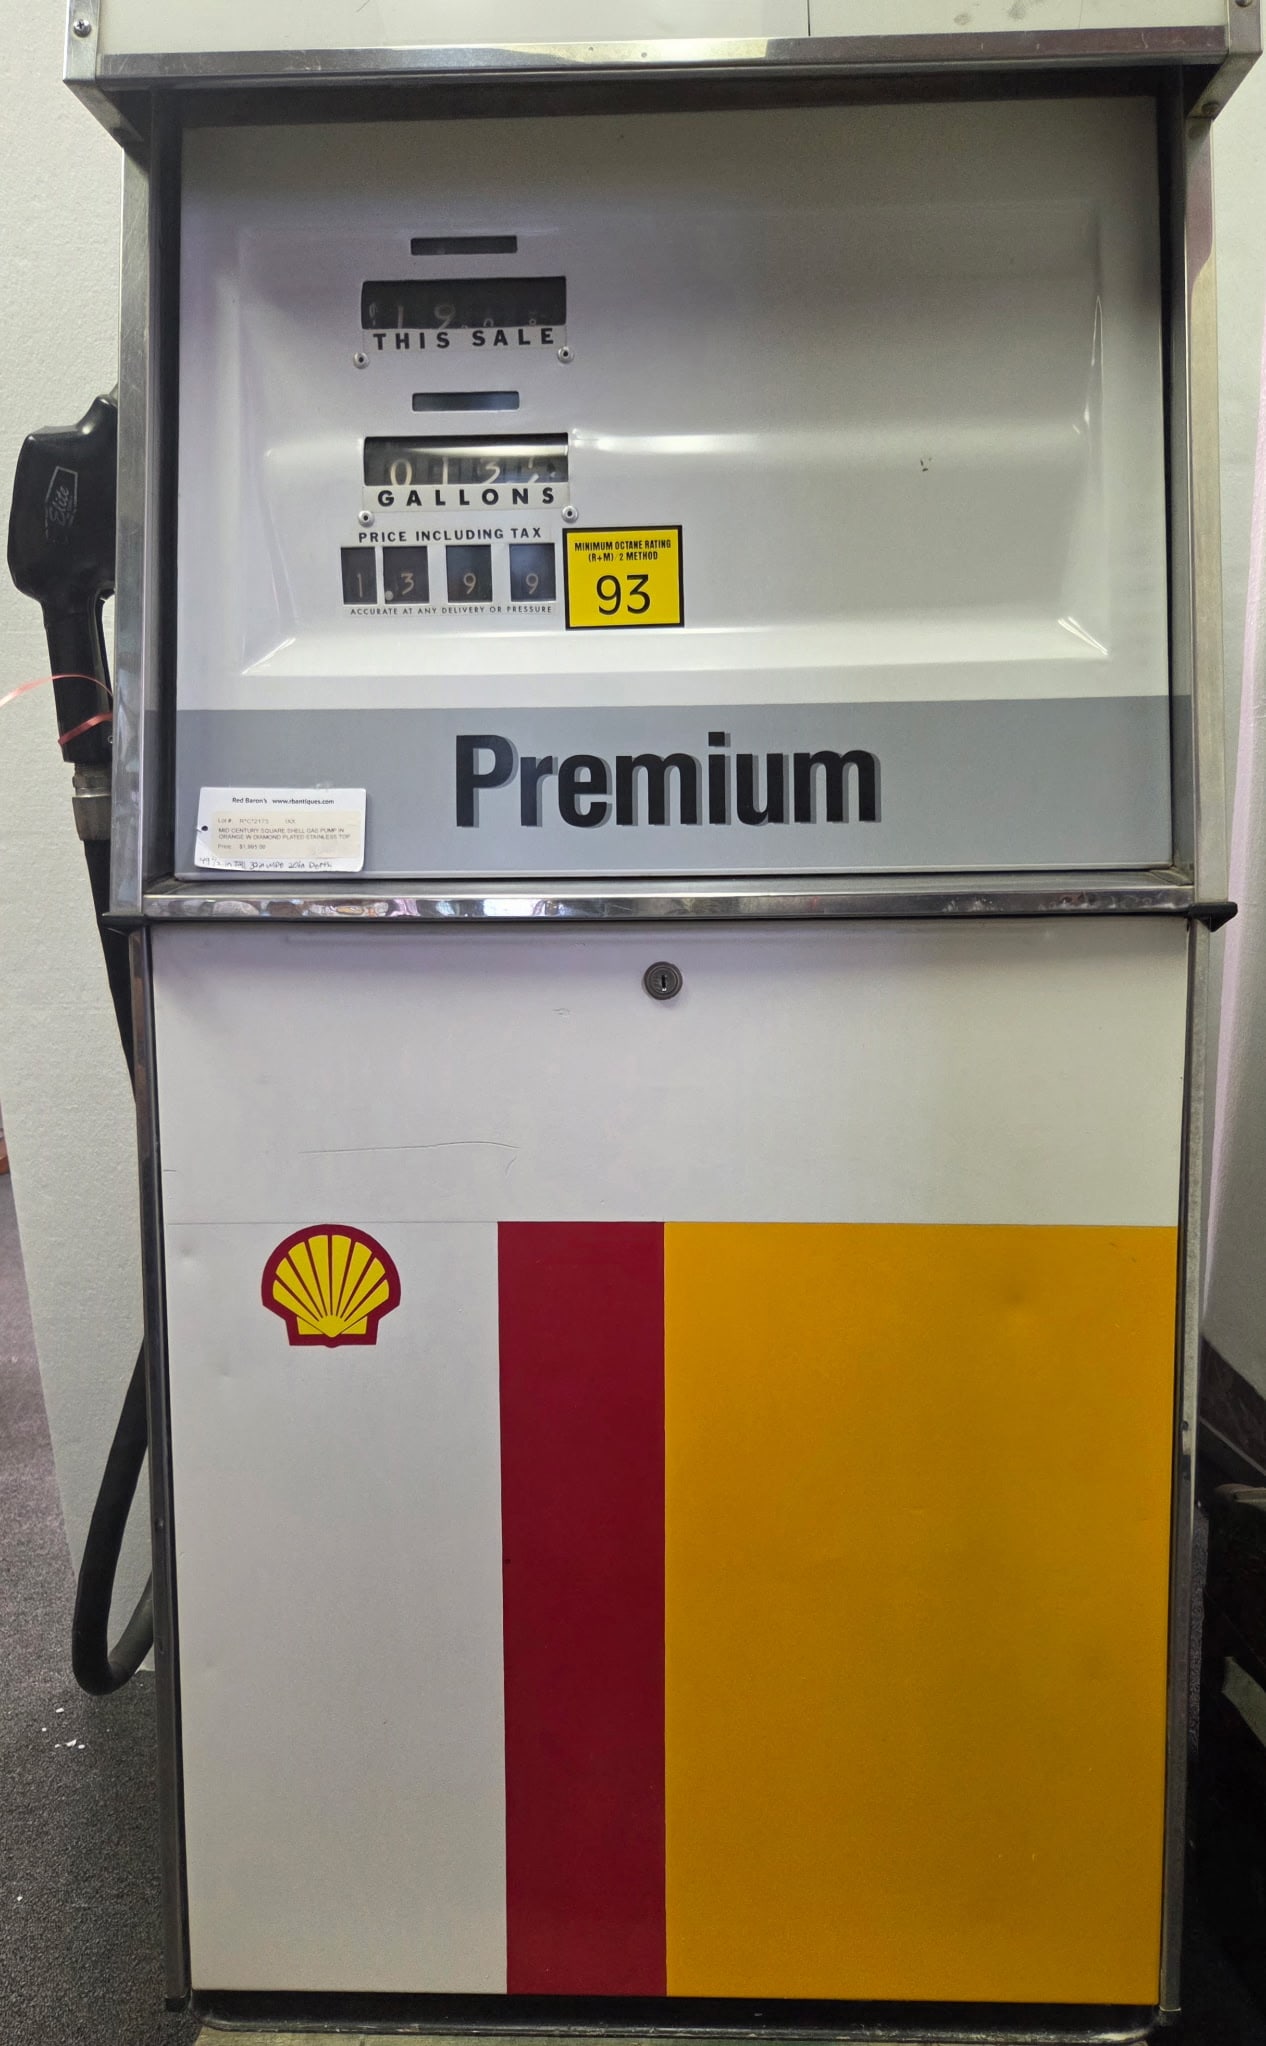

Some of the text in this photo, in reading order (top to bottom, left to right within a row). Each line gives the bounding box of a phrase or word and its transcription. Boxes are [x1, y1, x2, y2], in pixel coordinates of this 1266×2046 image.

[373, 328, 554, 350] THIS SALE
[377, 487, 554, 507] GALLONS
[359, 527, 541, 543] PRICE INCLUDING TAX
[574, 539, 671, 552] MINIMUM OCTANE RATING
[626, 551, 658, 561] METHOD
[596, 574, 651, 616] 93
[350, 606, 552, 616] ACCURATE AT ANY DELIVERY OR PRESSURE
[455, 731, 881, 828] Premium
